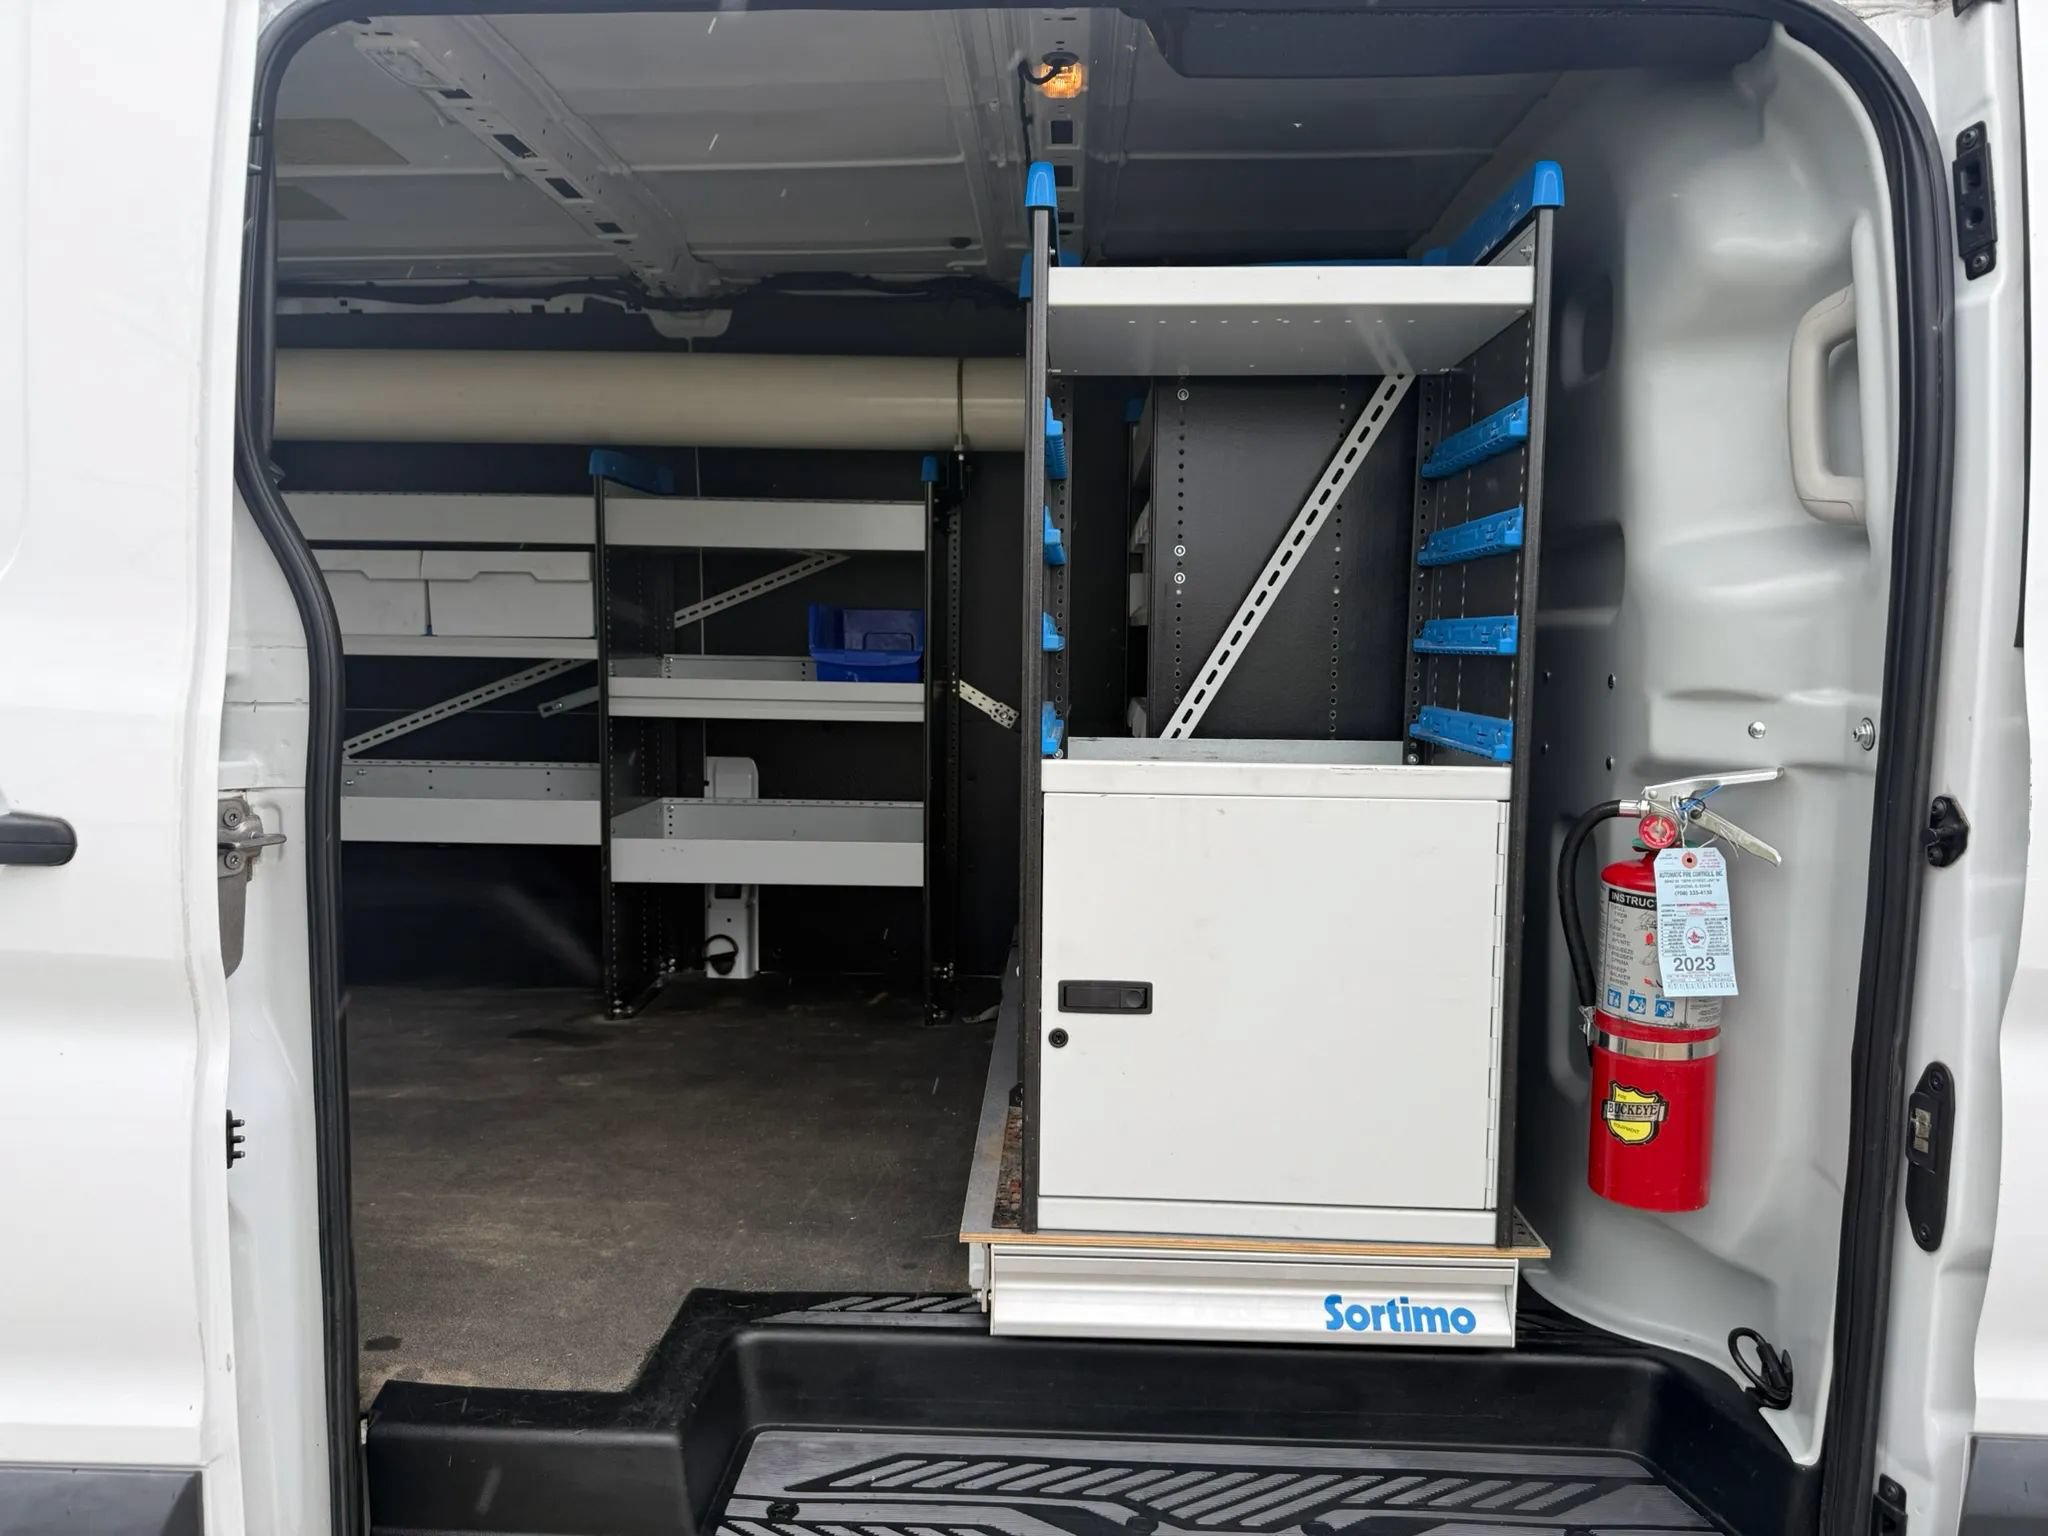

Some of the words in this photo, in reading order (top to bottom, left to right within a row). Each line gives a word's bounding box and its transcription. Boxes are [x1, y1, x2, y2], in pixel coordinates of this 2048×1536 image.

[1611, 891, 1655, 908] INSTRUC
[1673, 956, 1716, 972] 2023
[1608, 1102, 1658, 1116] BUCKEYE
[1324, 1294, 1477, 1334] Sortimo
